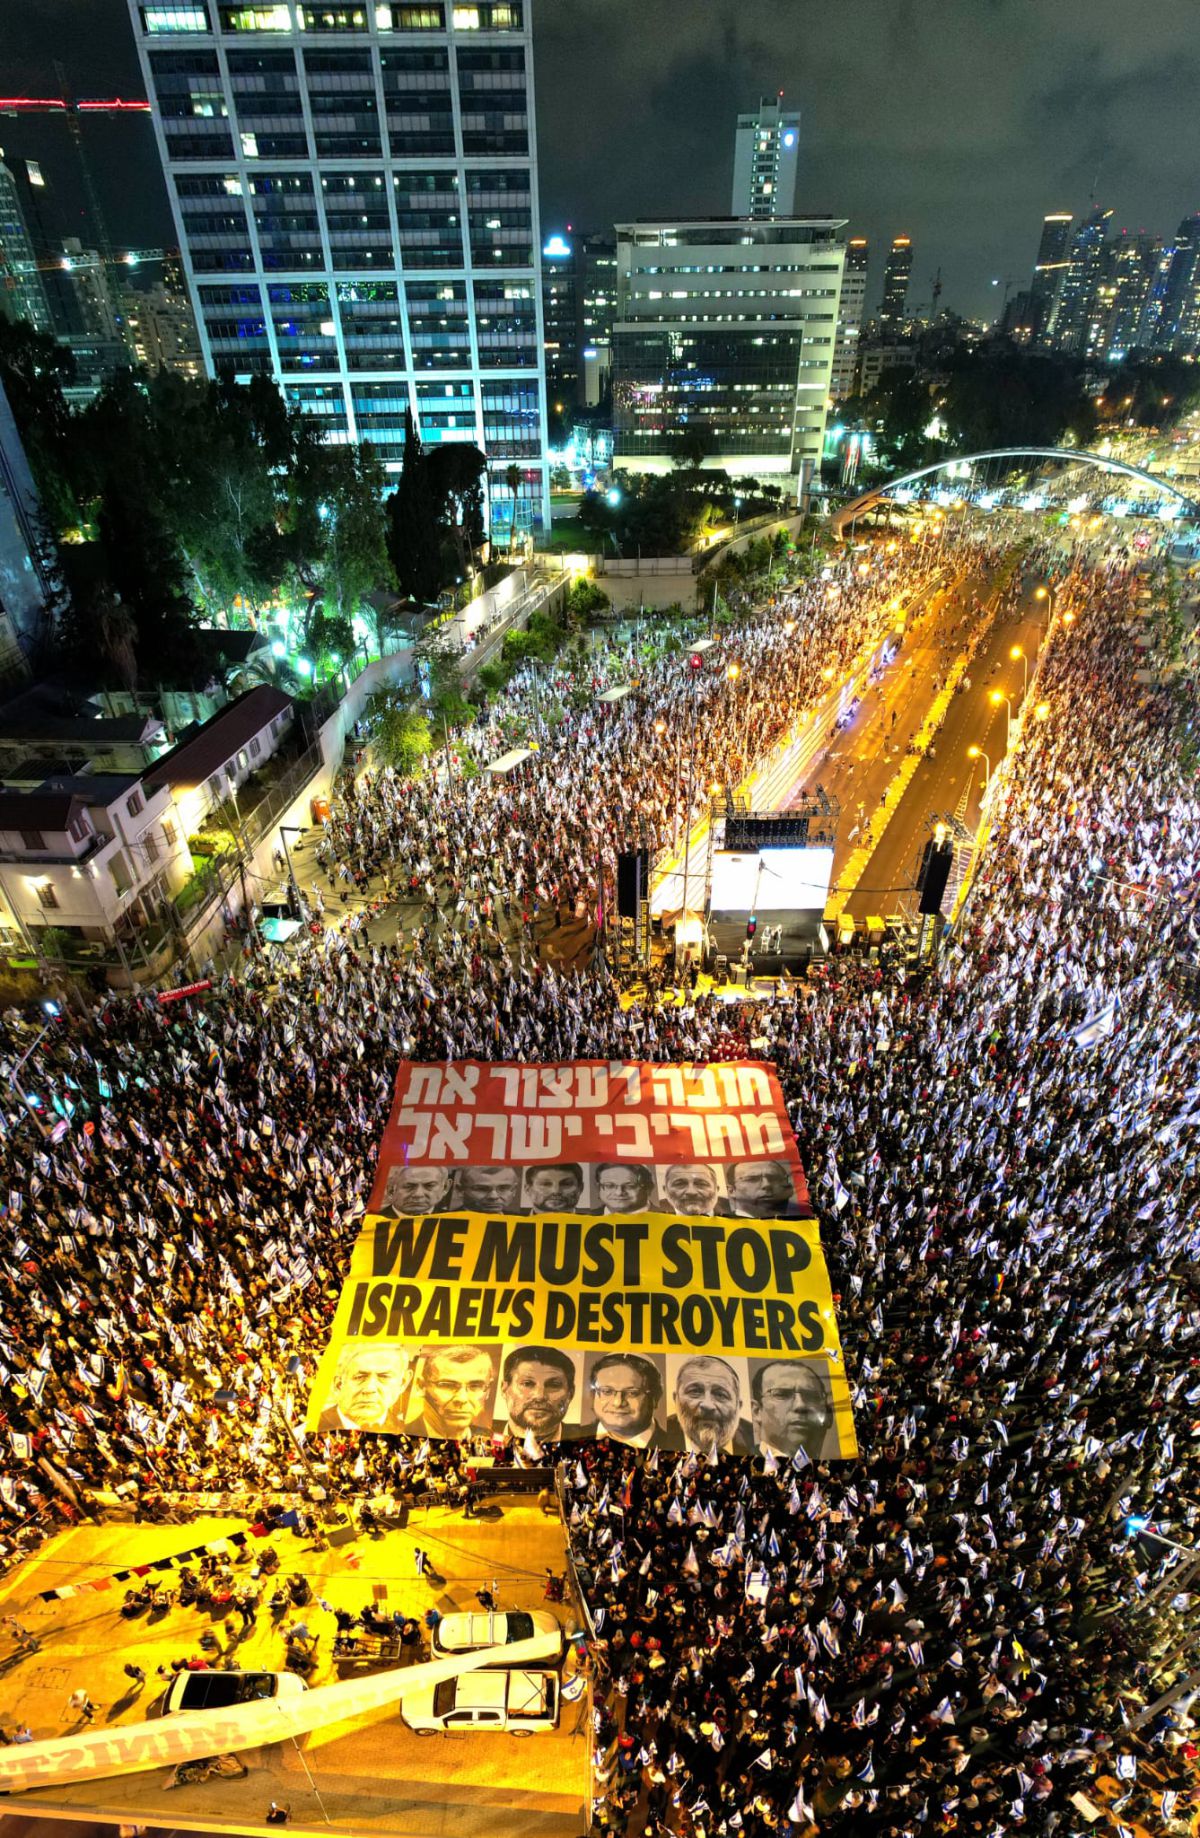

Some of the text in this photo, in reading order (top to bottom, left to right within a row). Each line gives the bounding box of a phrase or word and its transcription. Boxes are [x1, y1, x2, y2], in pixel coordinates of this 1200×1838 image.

[402, 1061, 773, 1108] חובה לעצור את
[398, 1107, 786, 1159] מחריבי ישראל
[372, 1217, 811, 1294] WE MUST STOP
[346, 1282, 824, 1352] ISRAEL'S DESTROYERS
